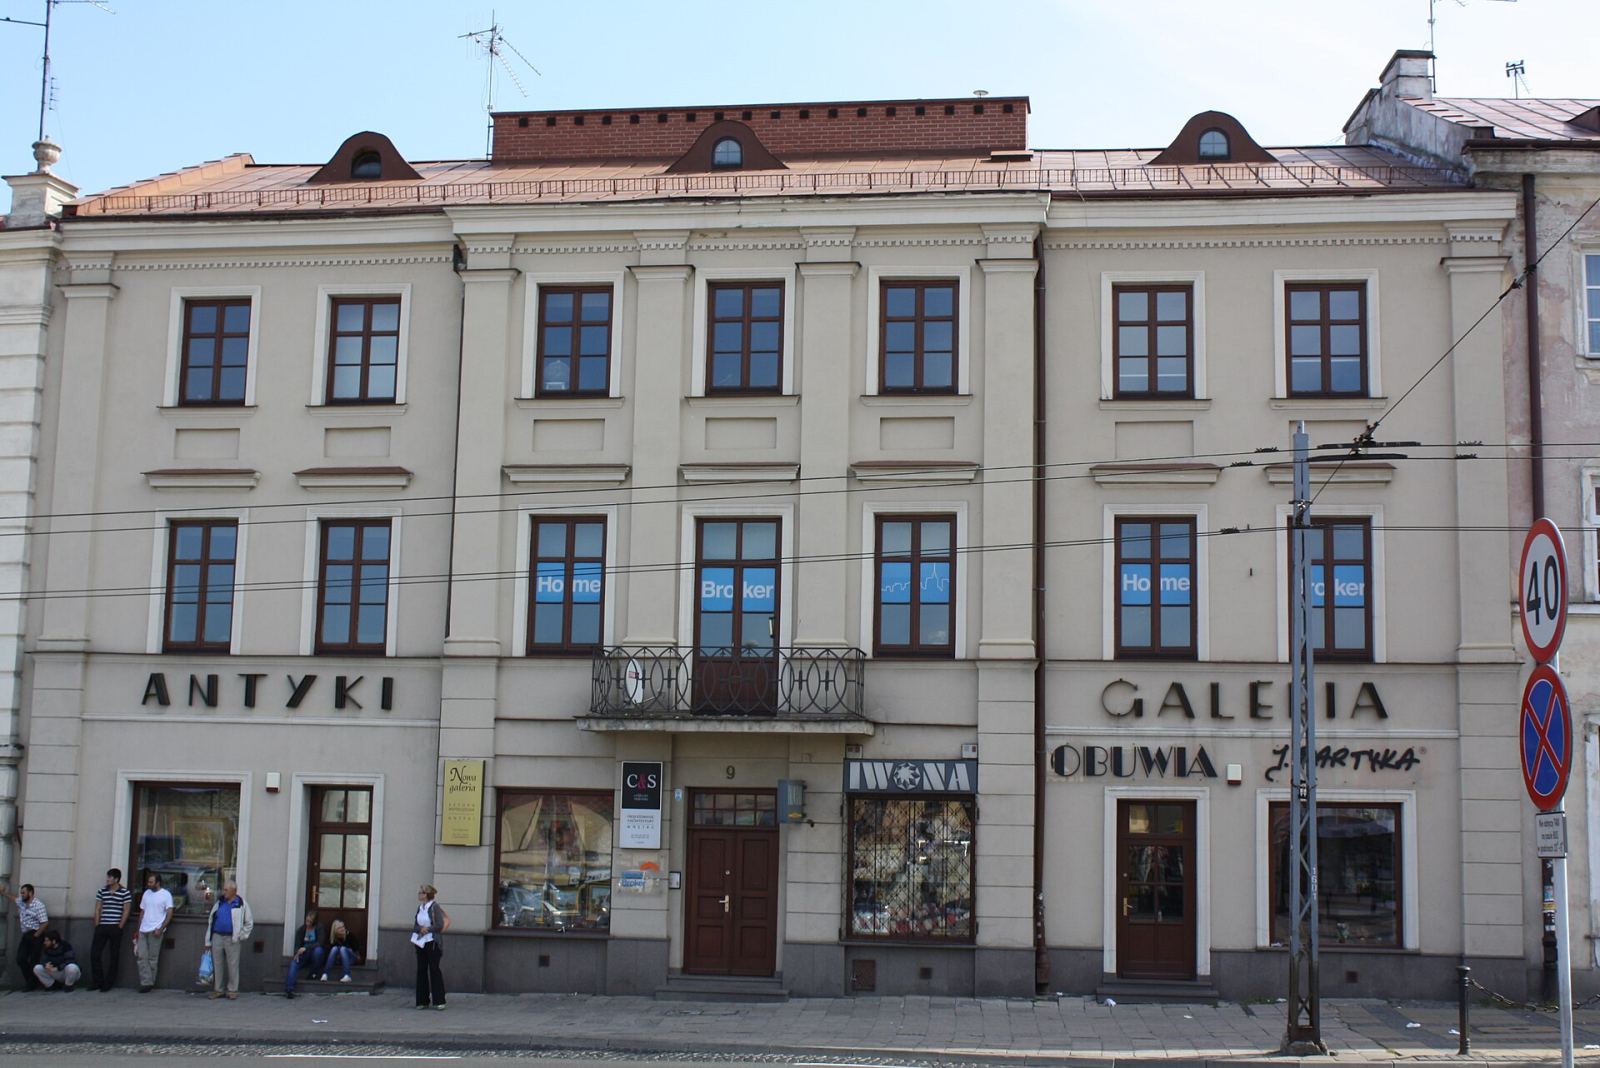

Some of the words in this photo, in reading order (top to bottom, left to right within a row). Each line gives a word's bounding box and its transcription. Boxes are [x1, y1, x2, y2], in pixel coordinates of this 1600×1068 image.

[538, 576, 600, 593] Home
[702, 581, 775, 598] Broker
[1123, 573, 1190, 591] Home
[1302, 579, 1365, 597] oker
[1526, 555, 1559, 626] 40
[141, 672, 394, 711] ANTYKI
[1101, 679, 1389, 720] GALEIA
[726, 765, 735, 780] 9
[1050, 744, 1218, 778] OBUWIA
[1299, 745, 1420, 773] ARTYKA
